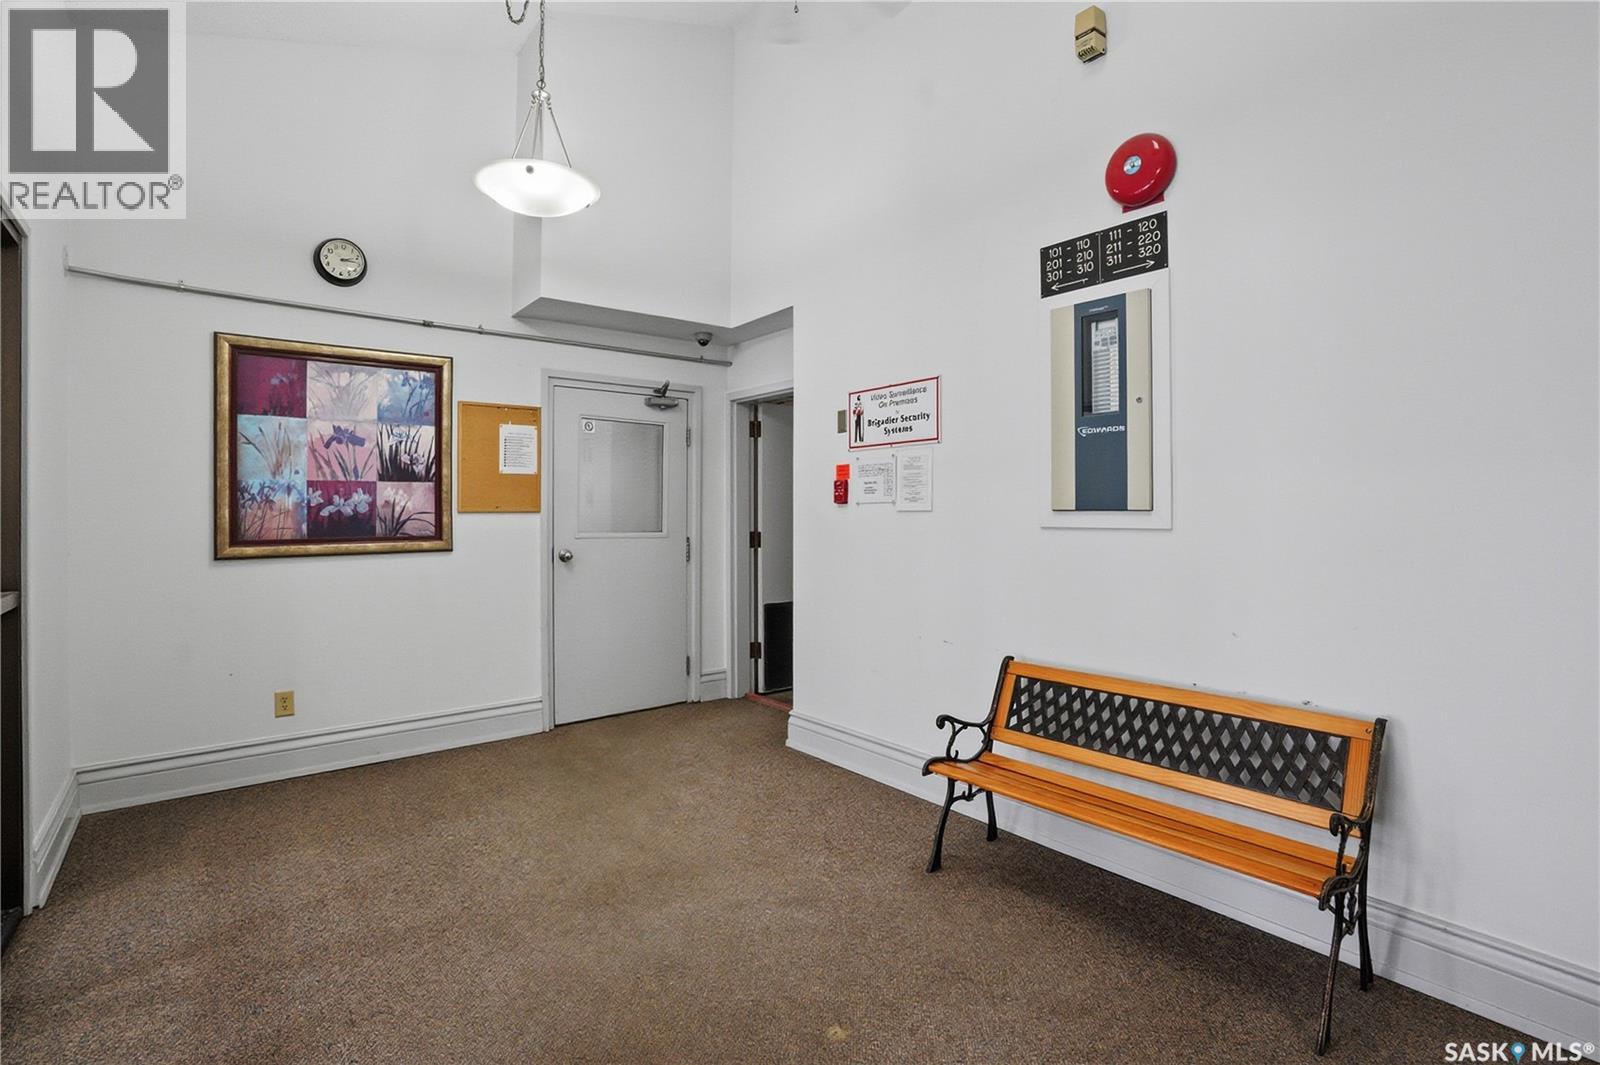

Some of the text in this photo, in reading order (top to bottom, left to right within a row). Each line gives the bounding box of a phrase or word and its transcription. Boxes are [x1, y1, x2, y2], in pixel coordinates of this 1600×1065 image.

[1109, 229, 1122, 241] 111
[1138, 218, 1157, 232] 120
[1049, 247, 1062, 258] 101
[1076, 238, 1090, 250] 110
[1106, 241, 1122, 254] 211
[1138, 230, 1161, 246] 220
[1046, 258, 1063, 271] 201
[1076, 250, 1094, 262] 210
[1106, 254, 1122, 266] 311
[1138, 243, 1162, 258] 320
[1046, 270, 1063, 282] 301
[1076, 262, 1094, 274] 310
[870, 393, 886, 402] Video
[878, 401, 888, 409] On
[868, 411, 931, 428] Brigadier Security
[884, 425, 914, 437] Systems
